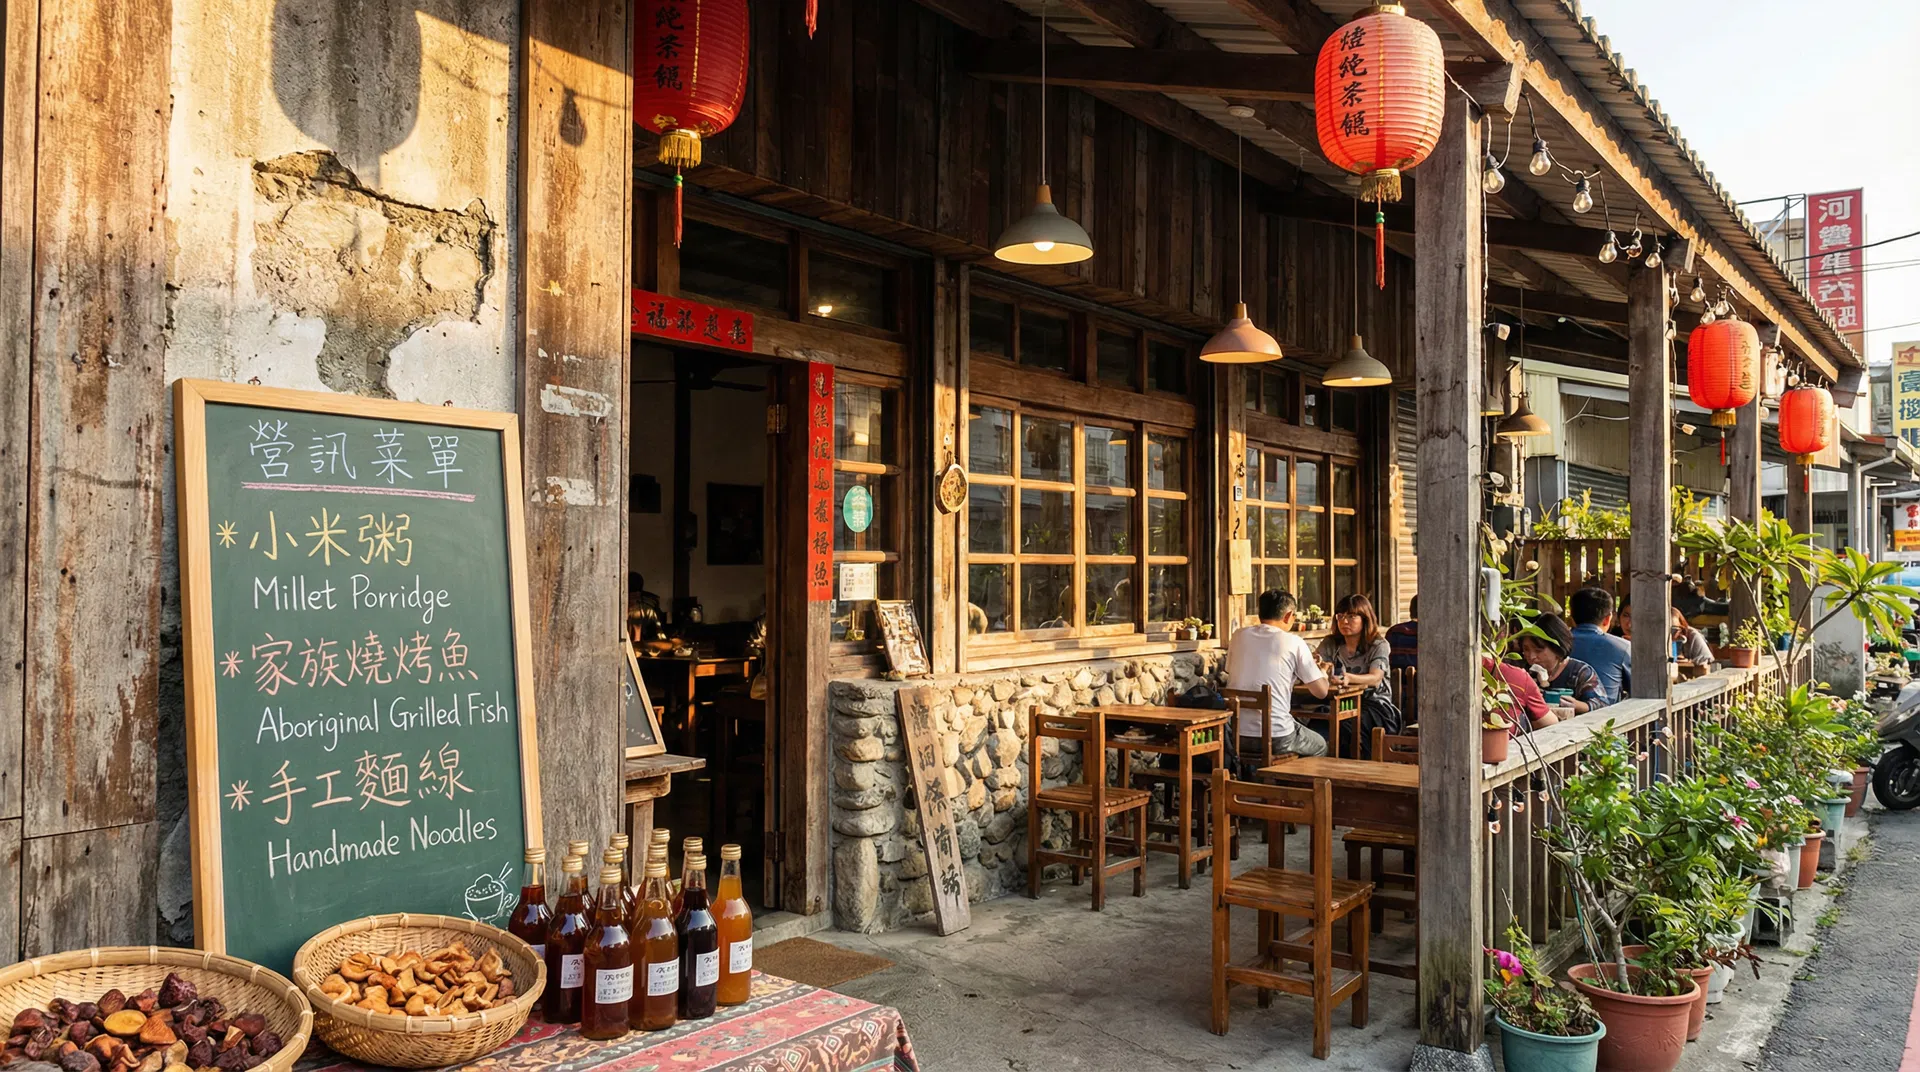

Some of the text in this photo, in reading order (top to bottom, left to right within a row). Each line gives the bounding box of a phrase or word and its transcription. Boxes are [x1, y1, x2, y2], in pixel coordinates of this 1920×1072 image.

[249, 419, 463, 488] 營訊菜單
[249, 508, 412, 566] 小米粥
[254, 574, 451, 624] Millet Porridge
[252, 628, 479, 696] 家族燒烤魚
[256, 691, 509, 751] Aboriginal Grilled Fish
[262, 741, 474, 825] 手工麵線
[268, 808, 498, 878] Handmade Noodles
